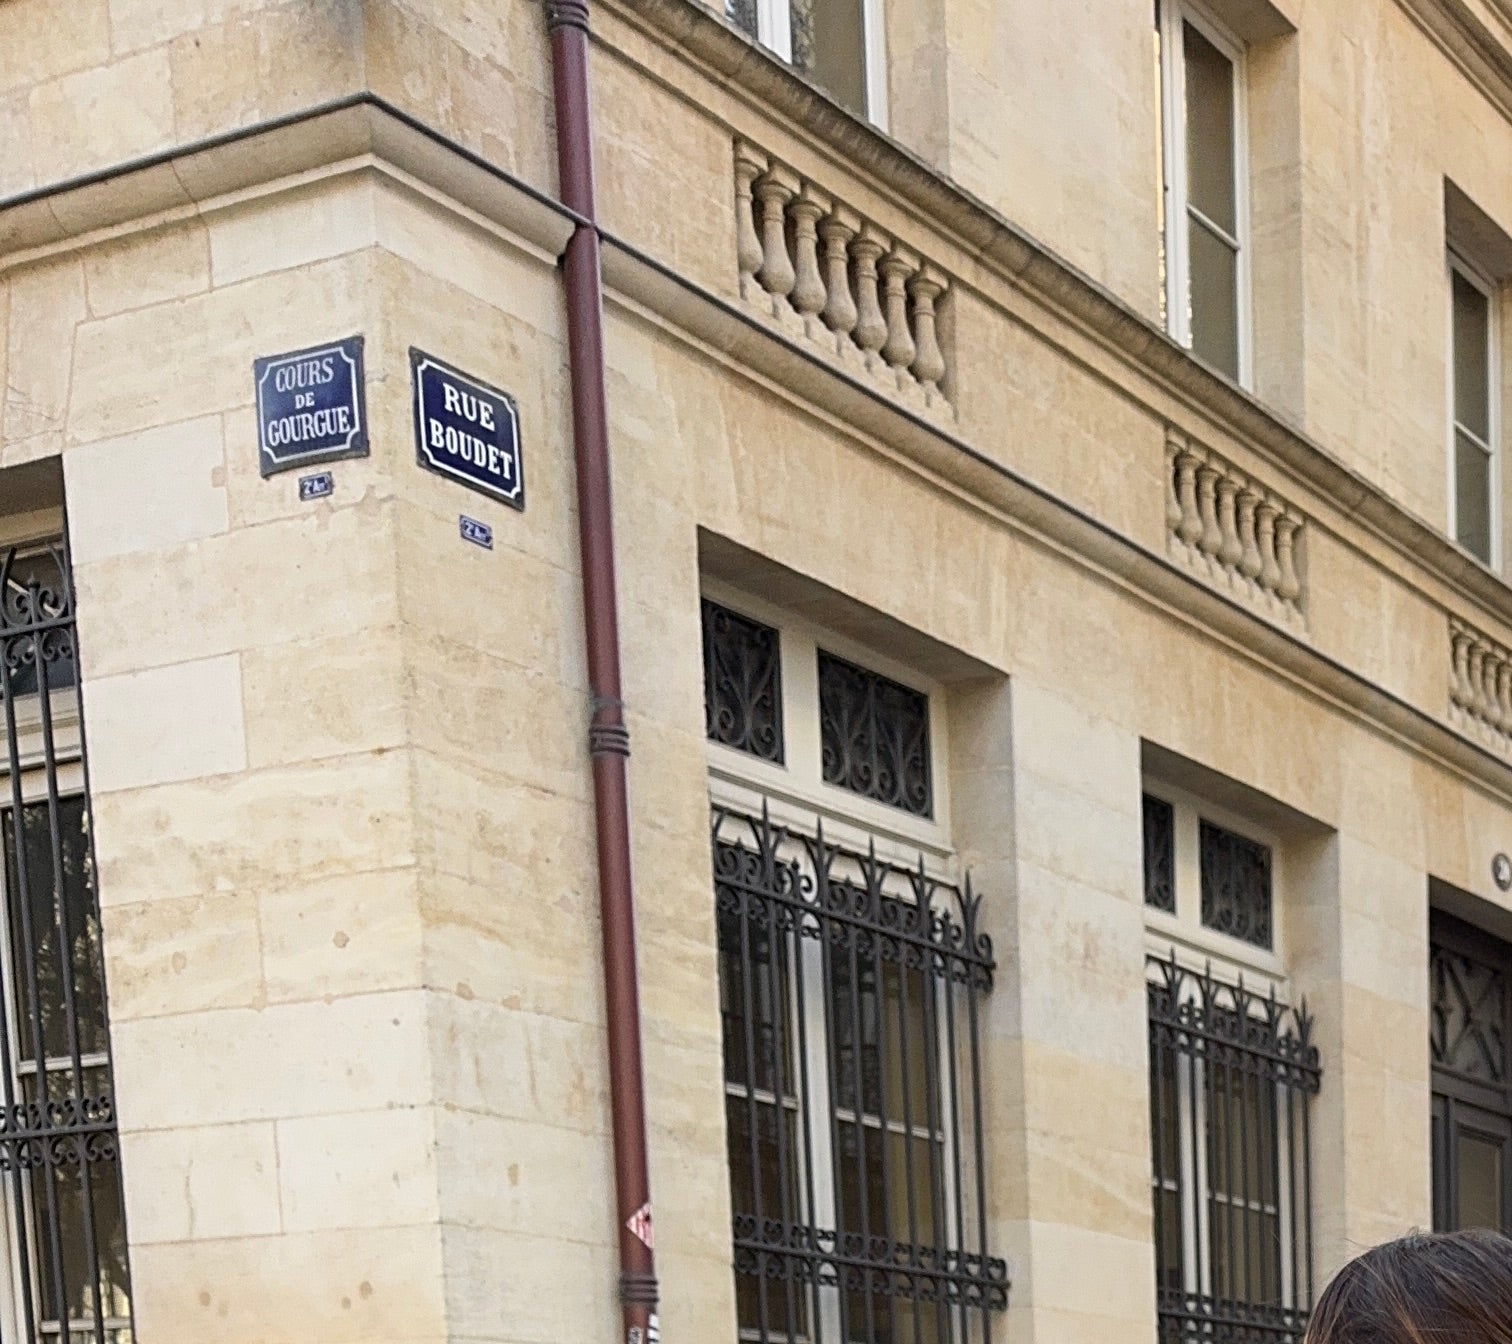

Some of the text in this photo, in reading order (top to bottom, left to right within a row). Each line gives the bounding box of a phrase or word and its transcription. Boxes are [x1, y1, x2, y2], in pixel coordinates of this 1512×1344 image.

[275, 356, 335, 393] COURS
[294, 392, 315, 409] DE
[443, 382, 496, 432] RUE
[267, 405, 351, 447] GOURGUE
[429, 417, 513, 481] BOUDET
